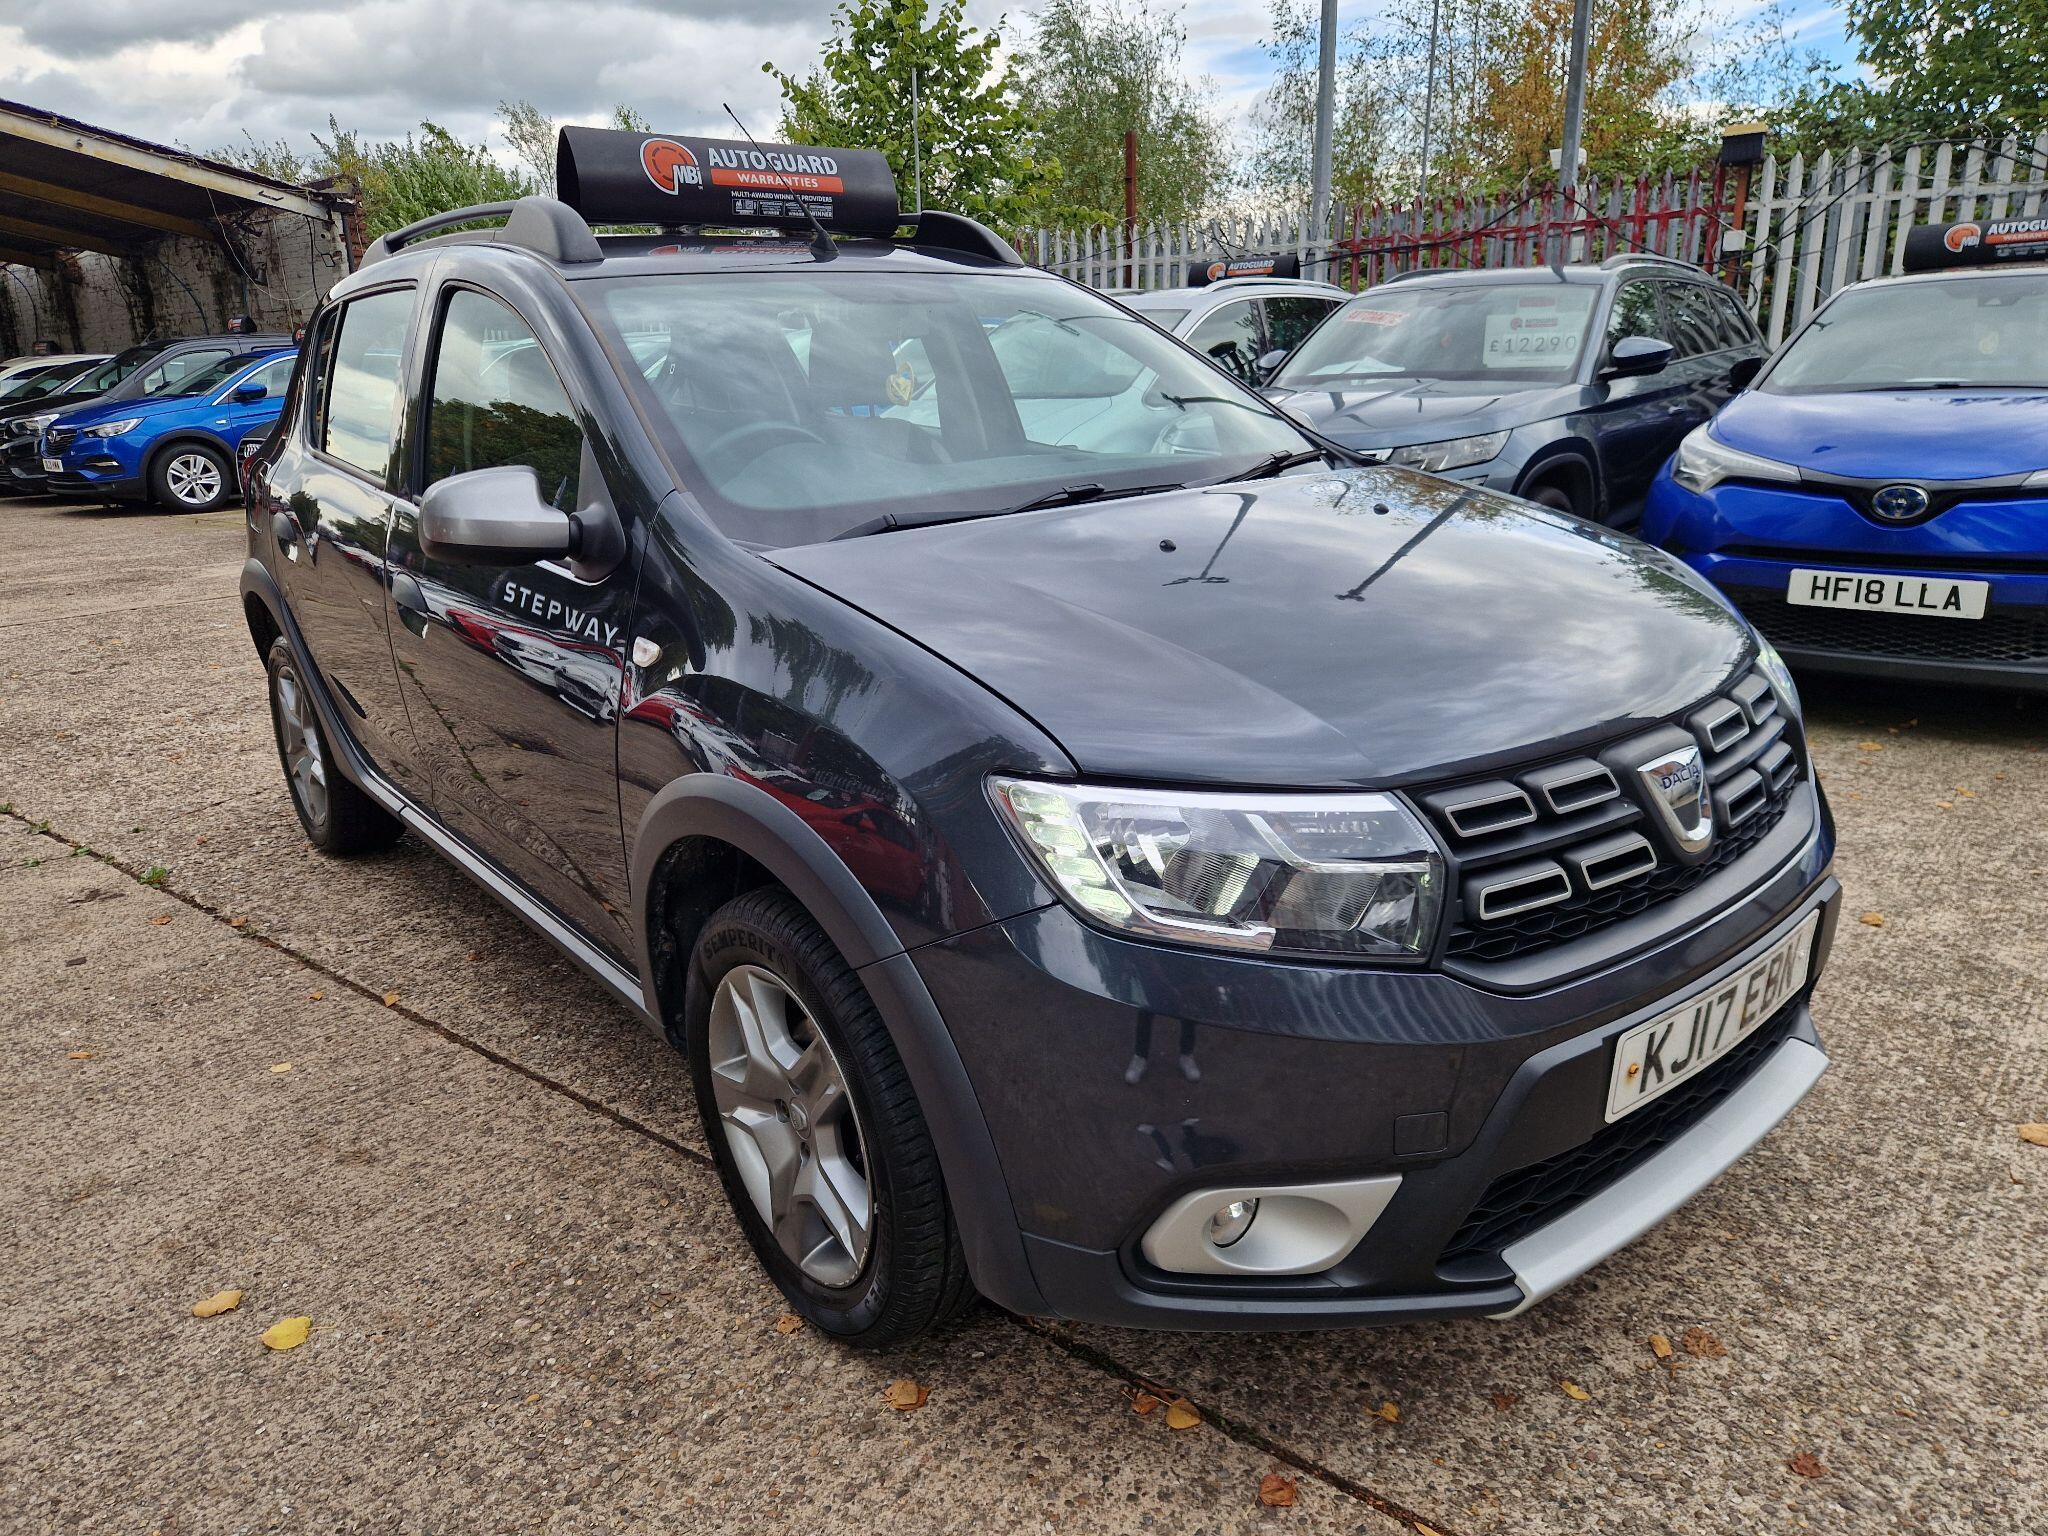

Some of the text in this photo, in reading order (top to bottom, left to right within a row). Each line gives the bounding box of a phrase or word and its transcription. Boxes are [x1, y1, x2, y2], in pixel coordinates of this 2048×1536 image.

[708, 147, 838, 175] AUTOGUARD
[737, 173, 819, 188] WARRANTIES
[801, 194, 833, 203] PROVIDERS
[1228, 260, 1275, 270] AUTOGUARD
[1810, 575, 1961, 611] HF18 LLA
[503, 581, 619, 647] STEPWAY
[1661, 764, 1700, 790] DACIA
[703, 928, 776, 962] SEMPERIT
